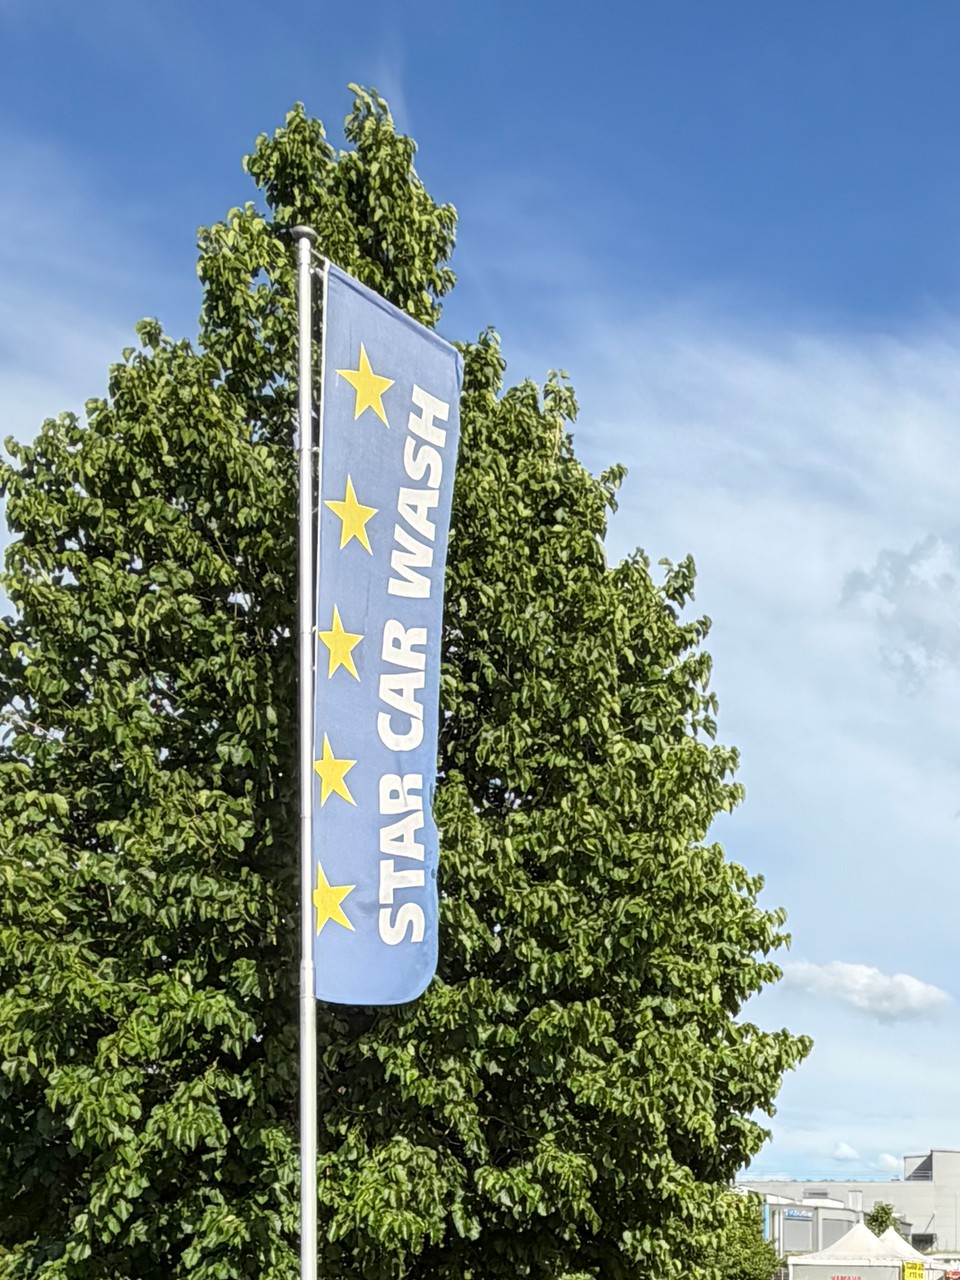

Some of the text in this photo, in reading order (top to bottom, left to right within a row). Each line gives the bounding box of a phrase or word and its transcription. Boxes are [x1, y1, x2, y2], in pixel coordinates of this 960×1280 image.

[377, 384, 450, 946] STAR CAR WASH
